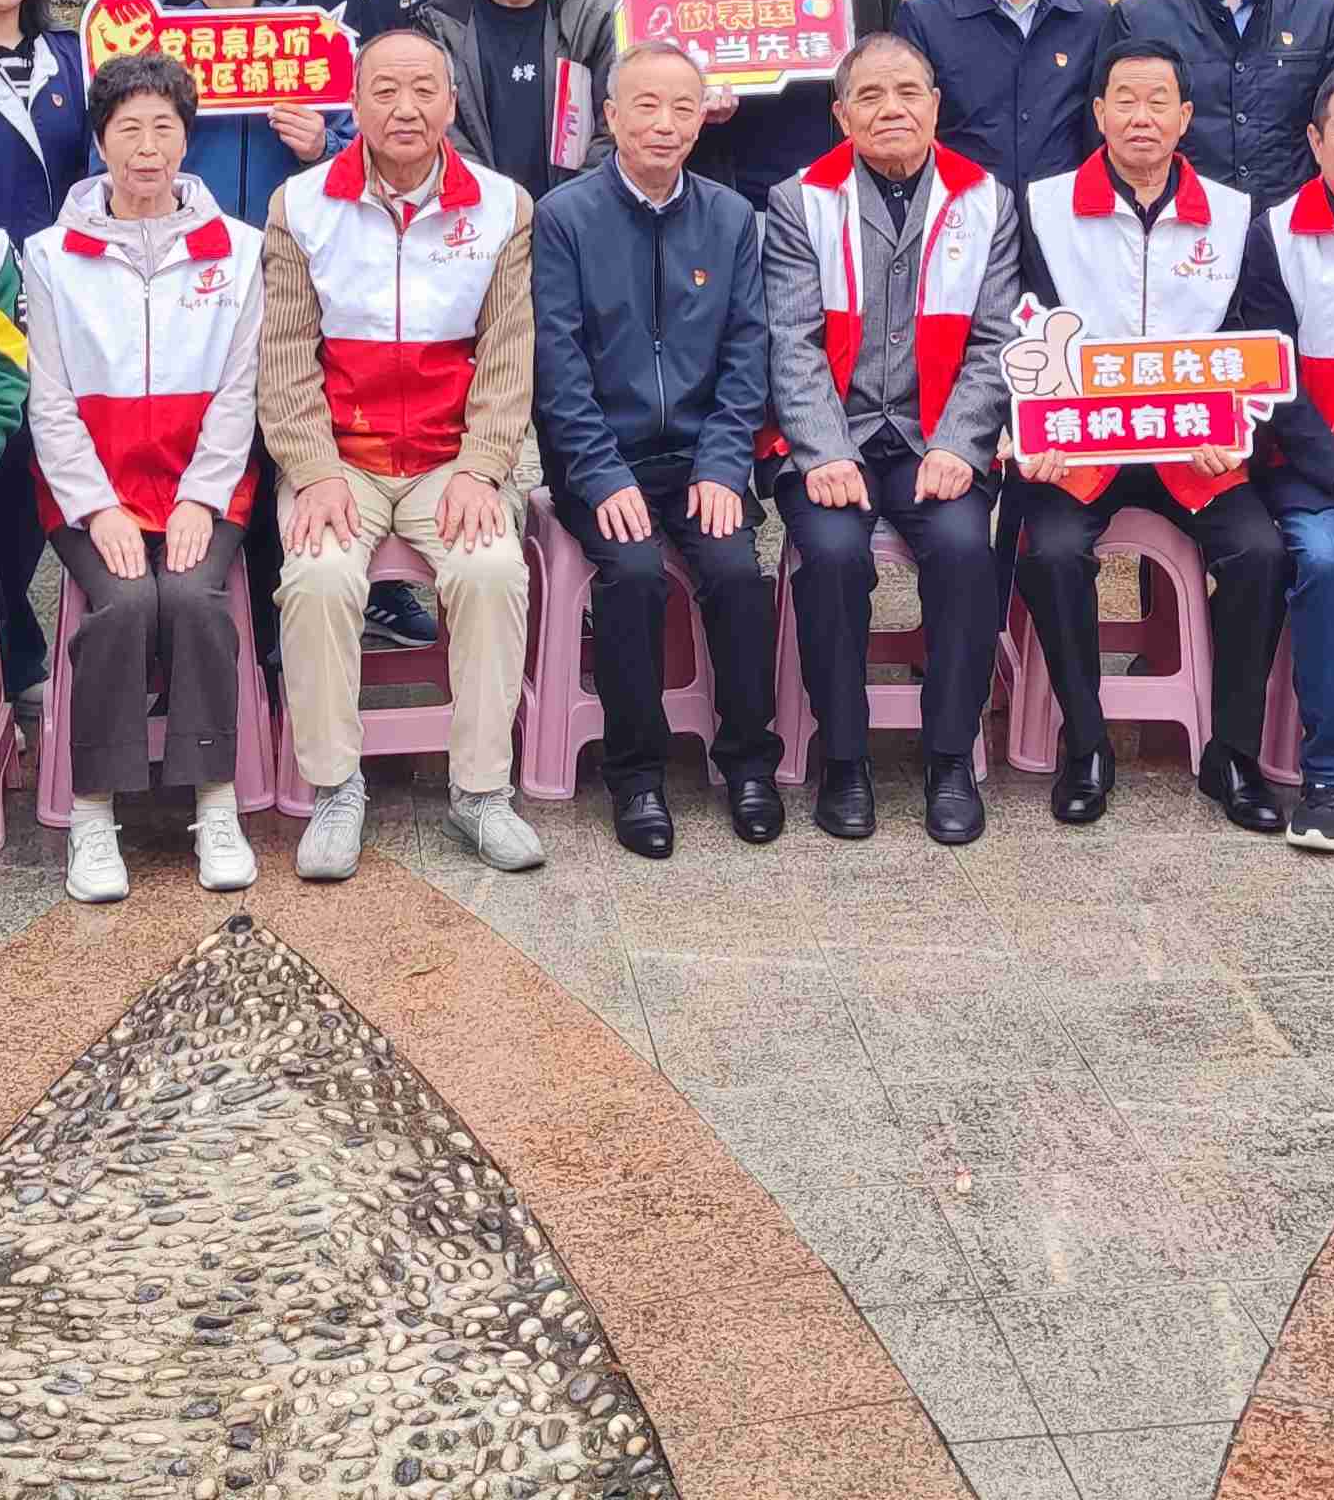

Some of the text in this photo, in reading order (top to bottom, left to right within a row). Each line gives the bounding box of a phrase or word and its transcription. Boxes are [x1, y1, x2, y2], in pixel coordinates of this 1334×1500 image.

[158, 25, 311, 59] 党员亮身份
[1092, 347, 1246, 388] 志愿先锋
[1044, 402, 1212, 444] 清枫有我
